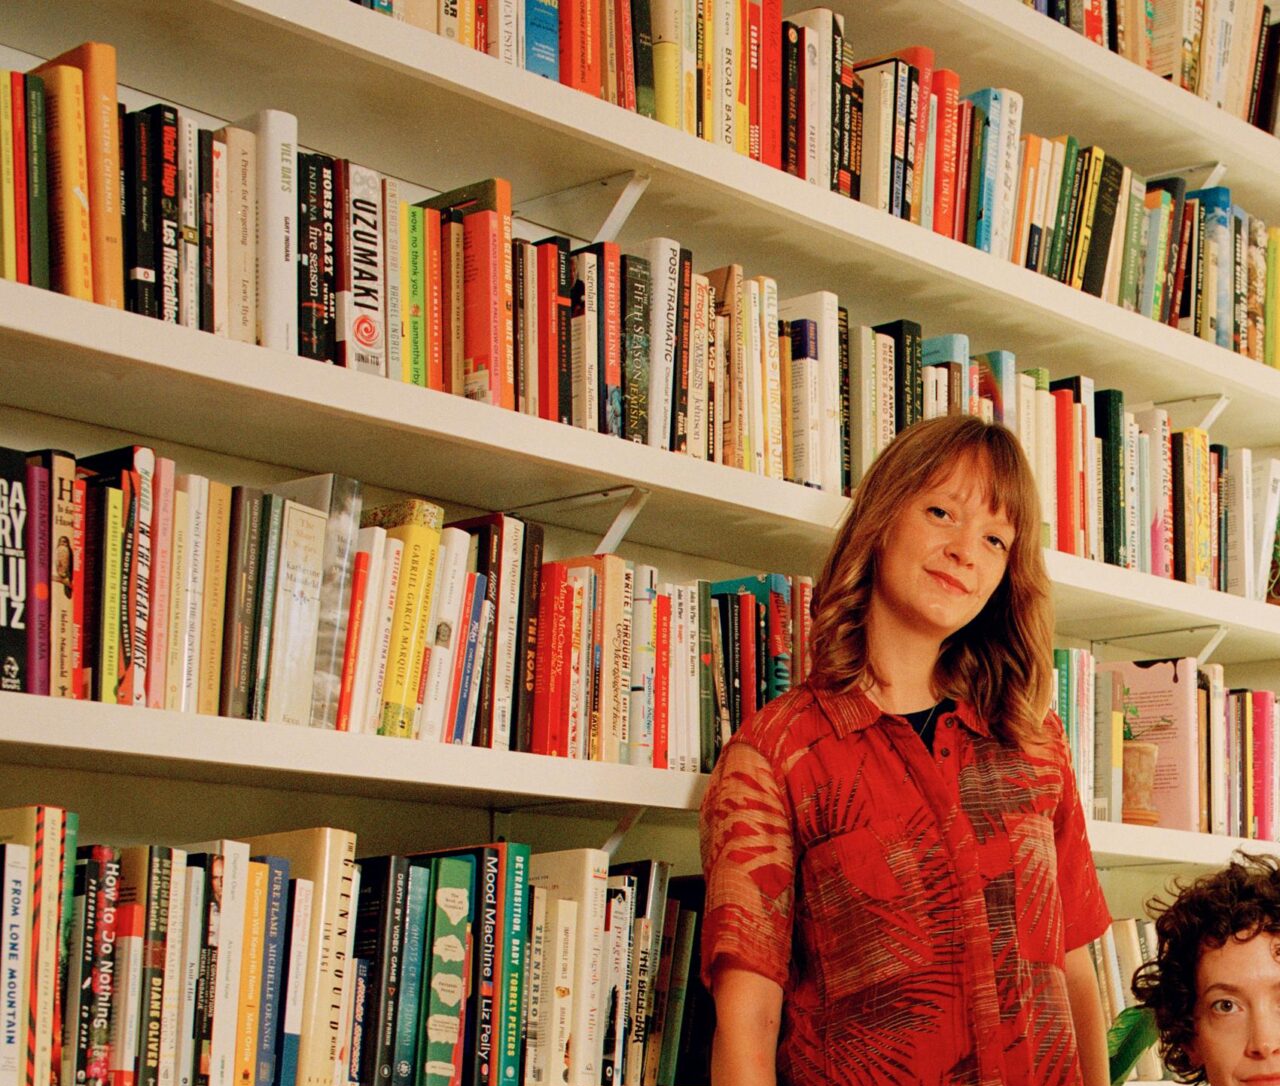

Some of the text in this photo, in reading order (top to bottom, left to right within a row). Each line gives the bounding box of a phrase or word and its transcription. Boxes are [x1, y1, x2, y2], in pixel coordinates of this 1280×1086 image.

[919, 105, 929, 132] Season
[241, 159, 250, 186] Primer
[281, 143, 292, 192] VILE DAYS
[1072, 174, 1081, 196] GOOD
[163, 126, 178, 322] Victor Hugo Les Misérables
[240, 205, 250, 246] Forgetting
[309, 226, 322, 250] fire
[323, 168, 334, 276] HORSE CRAZY
[1067, 199, 1076, 235] SOLDIERS
[309, 252, 321, 297] season
[352, 198, 379, 312] UZUMAKI
[410, 251, 420, 278] thank
[559, 251, 569, 286] jarman
[391, 286, 400, 319] RACHEL
[407, 279, 418, 299] you.
[586, 263, 595, 312] Negroland
[664, 248, 678, 363] POST-TRAUMATIC
[768, 286, 778, 308] ALL
[240, 306, 249, 327] Hyde
[768, 315, 779, 357] FOURS
[391, 324, 400, 361] INGALLS
[411, 321, 421, 363] samantha
[608, 321, 617, 367] JELINEK
[632, 326, 643, 380] SEASON
[139, 521, 150, 535] IN
[138, 543, 150, 568] THE
[408, 544, 420, 587] GABRIEL
[136, 573, 149, 619] DREAM
[623, 572, 632, 607] WRITE
[134, 624, 147, 670] HOUSE
[556, 581, 568, 673] Mary McCarthy
[622, 619, 633, 669] THROUGH
[525, 618, 537, 691] THE ROAD
[103, 863, 118, 901] How
[337, 858, 355, 938] GLENN
[395, 873, 404, 901] DEATH
[86, 879, 97, 931] PERSONAL
[100, 907, 115, 924] to
[6, 880, 21, 1044] FROM LONE MOUNTAIN
[262, 870, 282, 1050] PURE FLAME MICHELLE ORANGE
[476, 857, 499, 1060] Mood Machine Liz Pelly
[506, 856, 524, 1056] DETRANSITION, BABY TORREY PETERS
[94, 960, 114, 1029] Nothing
[147, 977, 163, 1068] DIANE OLIVER
